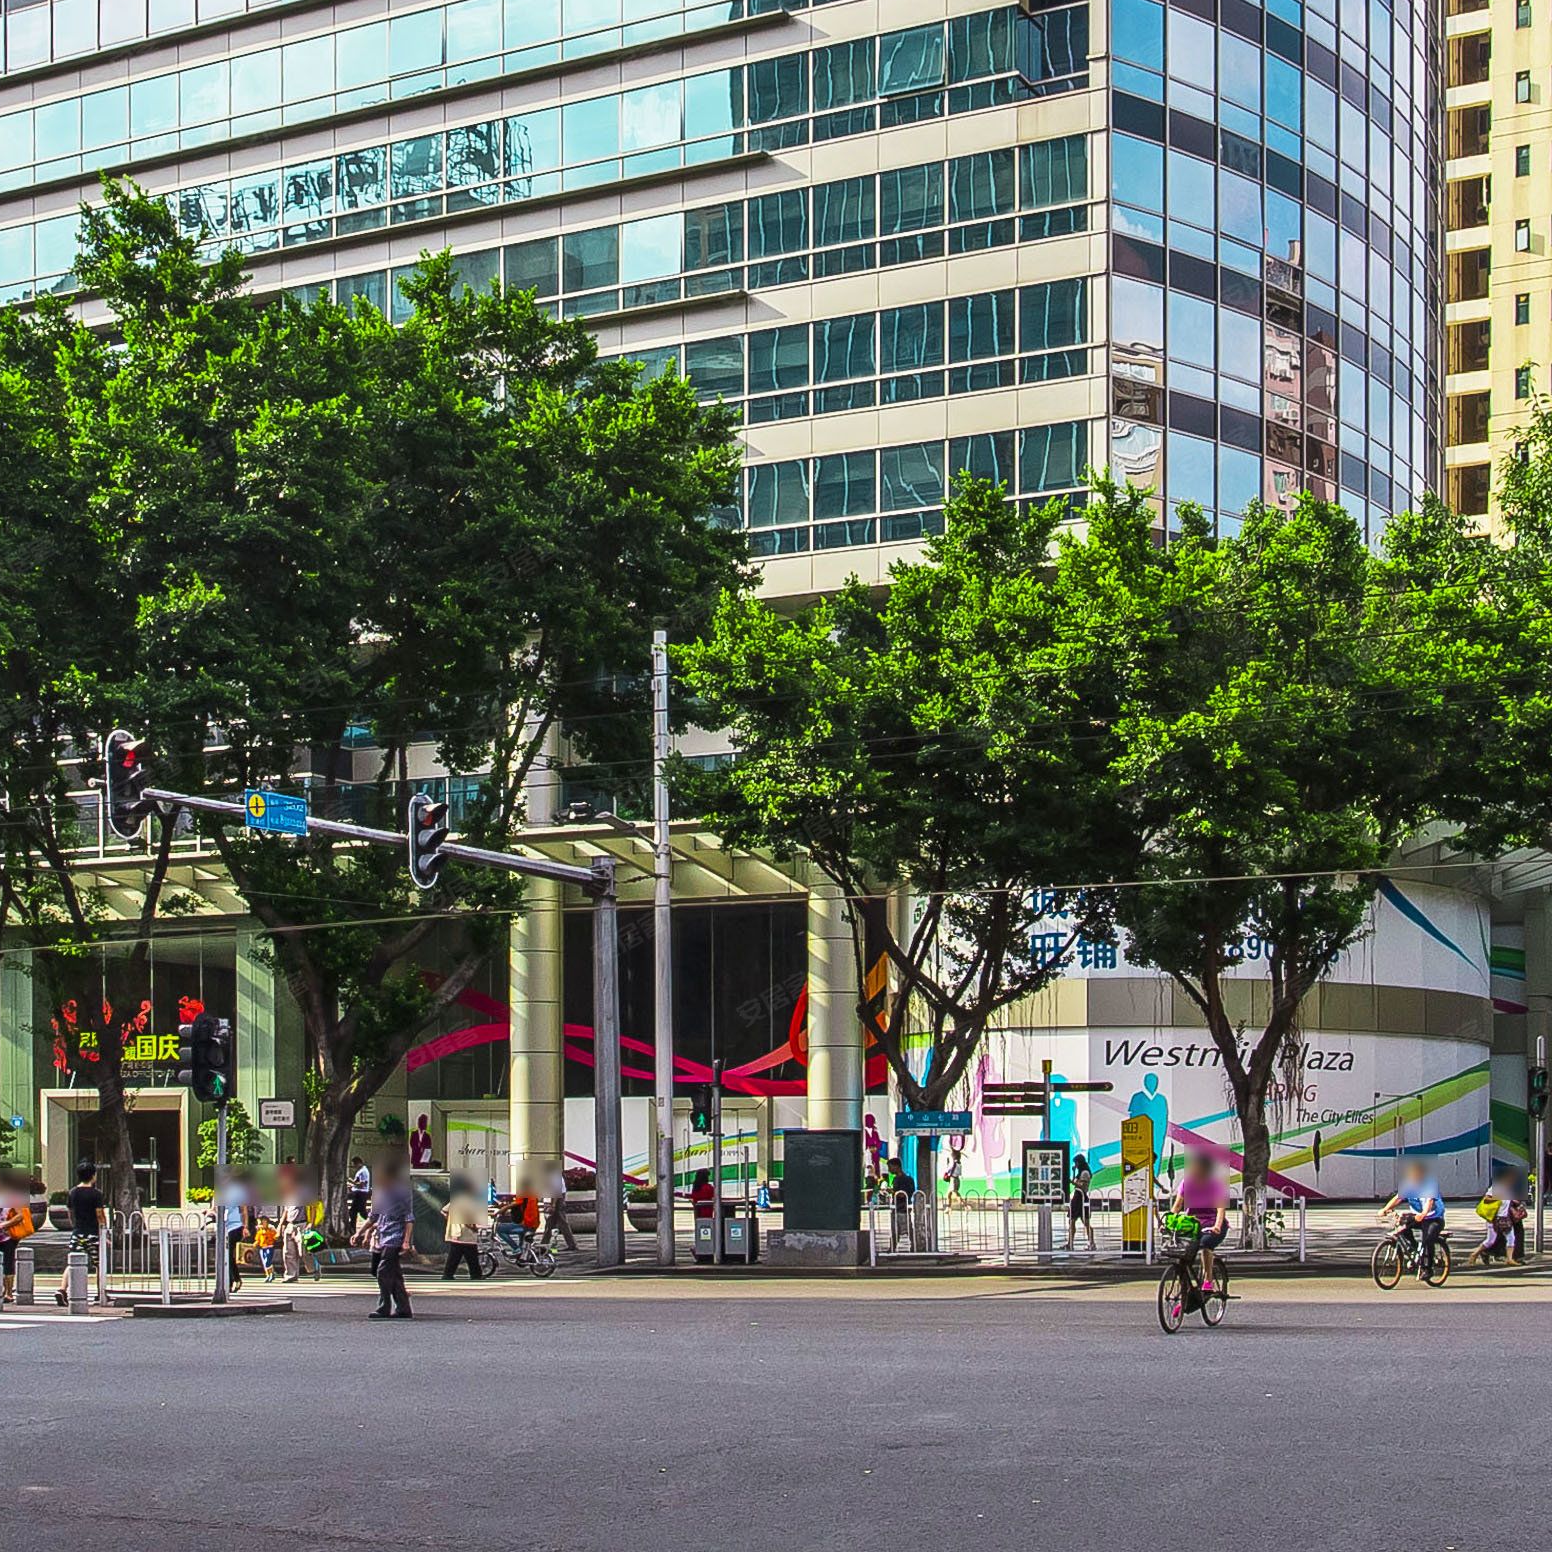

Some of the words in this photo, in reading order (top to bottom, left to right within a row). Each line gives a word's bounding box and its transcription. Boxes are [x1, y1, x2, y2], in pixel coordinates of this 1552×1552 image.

[1278, 1042, 1355, 1071] Plaza
[1296, 1108, 1319, 1123] The
[1321, 1108, 1344, 1126] City
[1345, 1110, 1374, 1124] Elites
